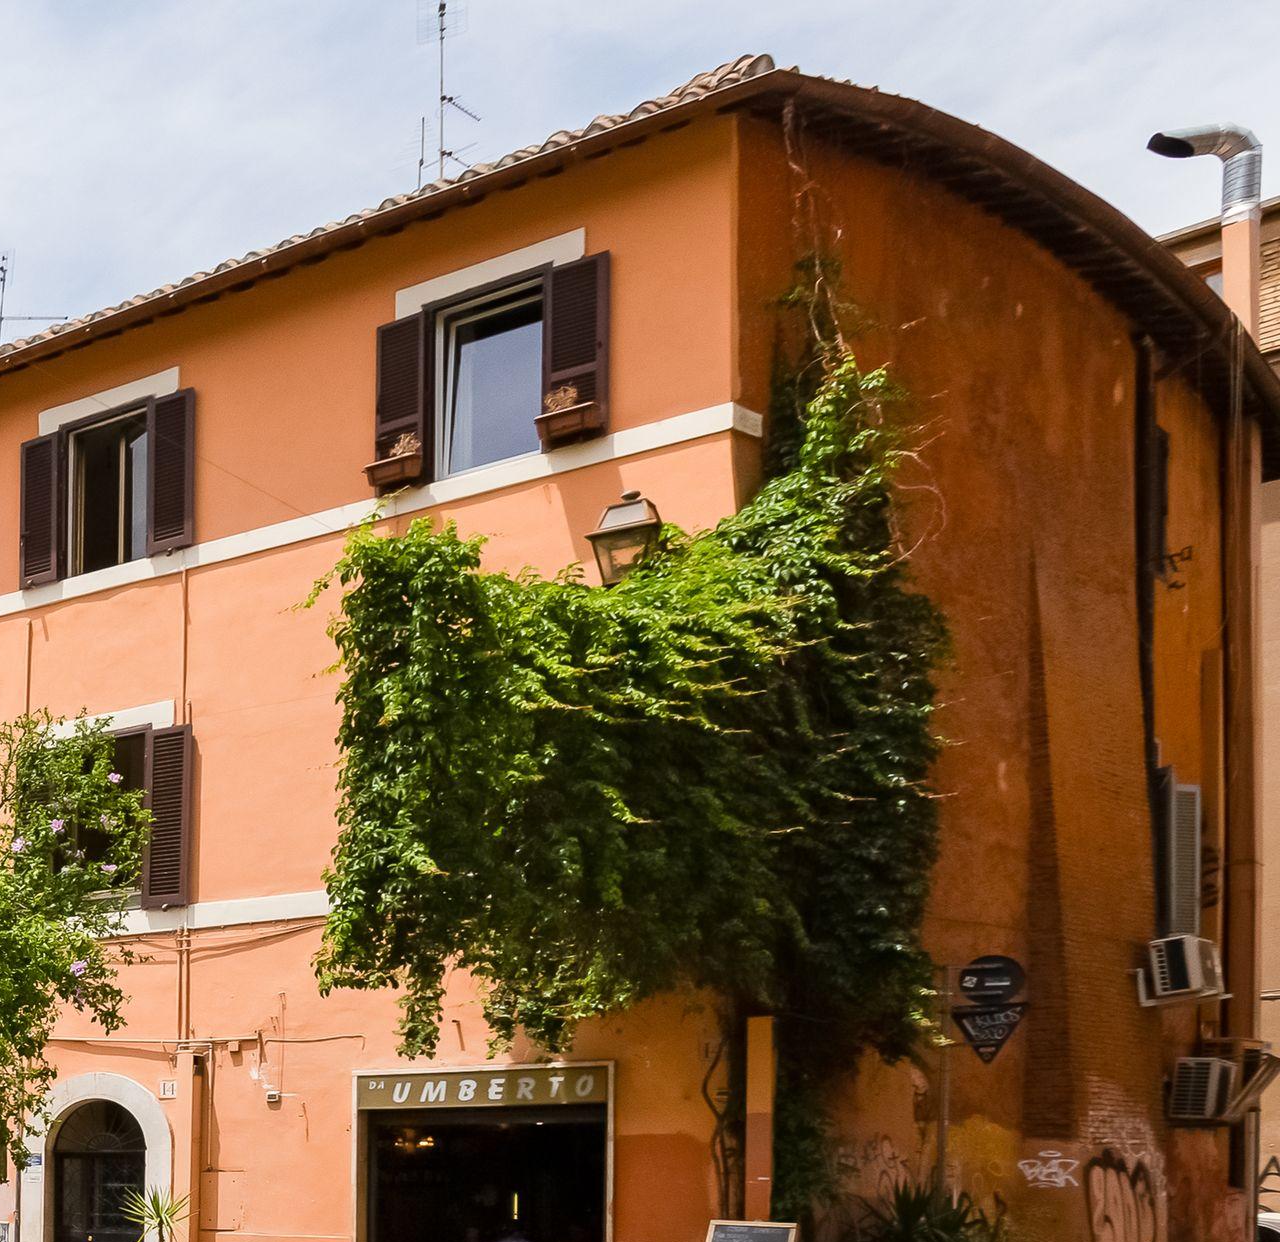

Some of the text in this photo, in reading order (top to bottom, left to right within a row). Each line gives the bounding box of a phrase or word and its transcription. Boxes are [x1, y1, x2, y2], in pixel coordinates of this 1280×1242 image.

[162, 1082, 176, 1096] 14
[369, 1074, 595, 1103] DA UMBERTO
